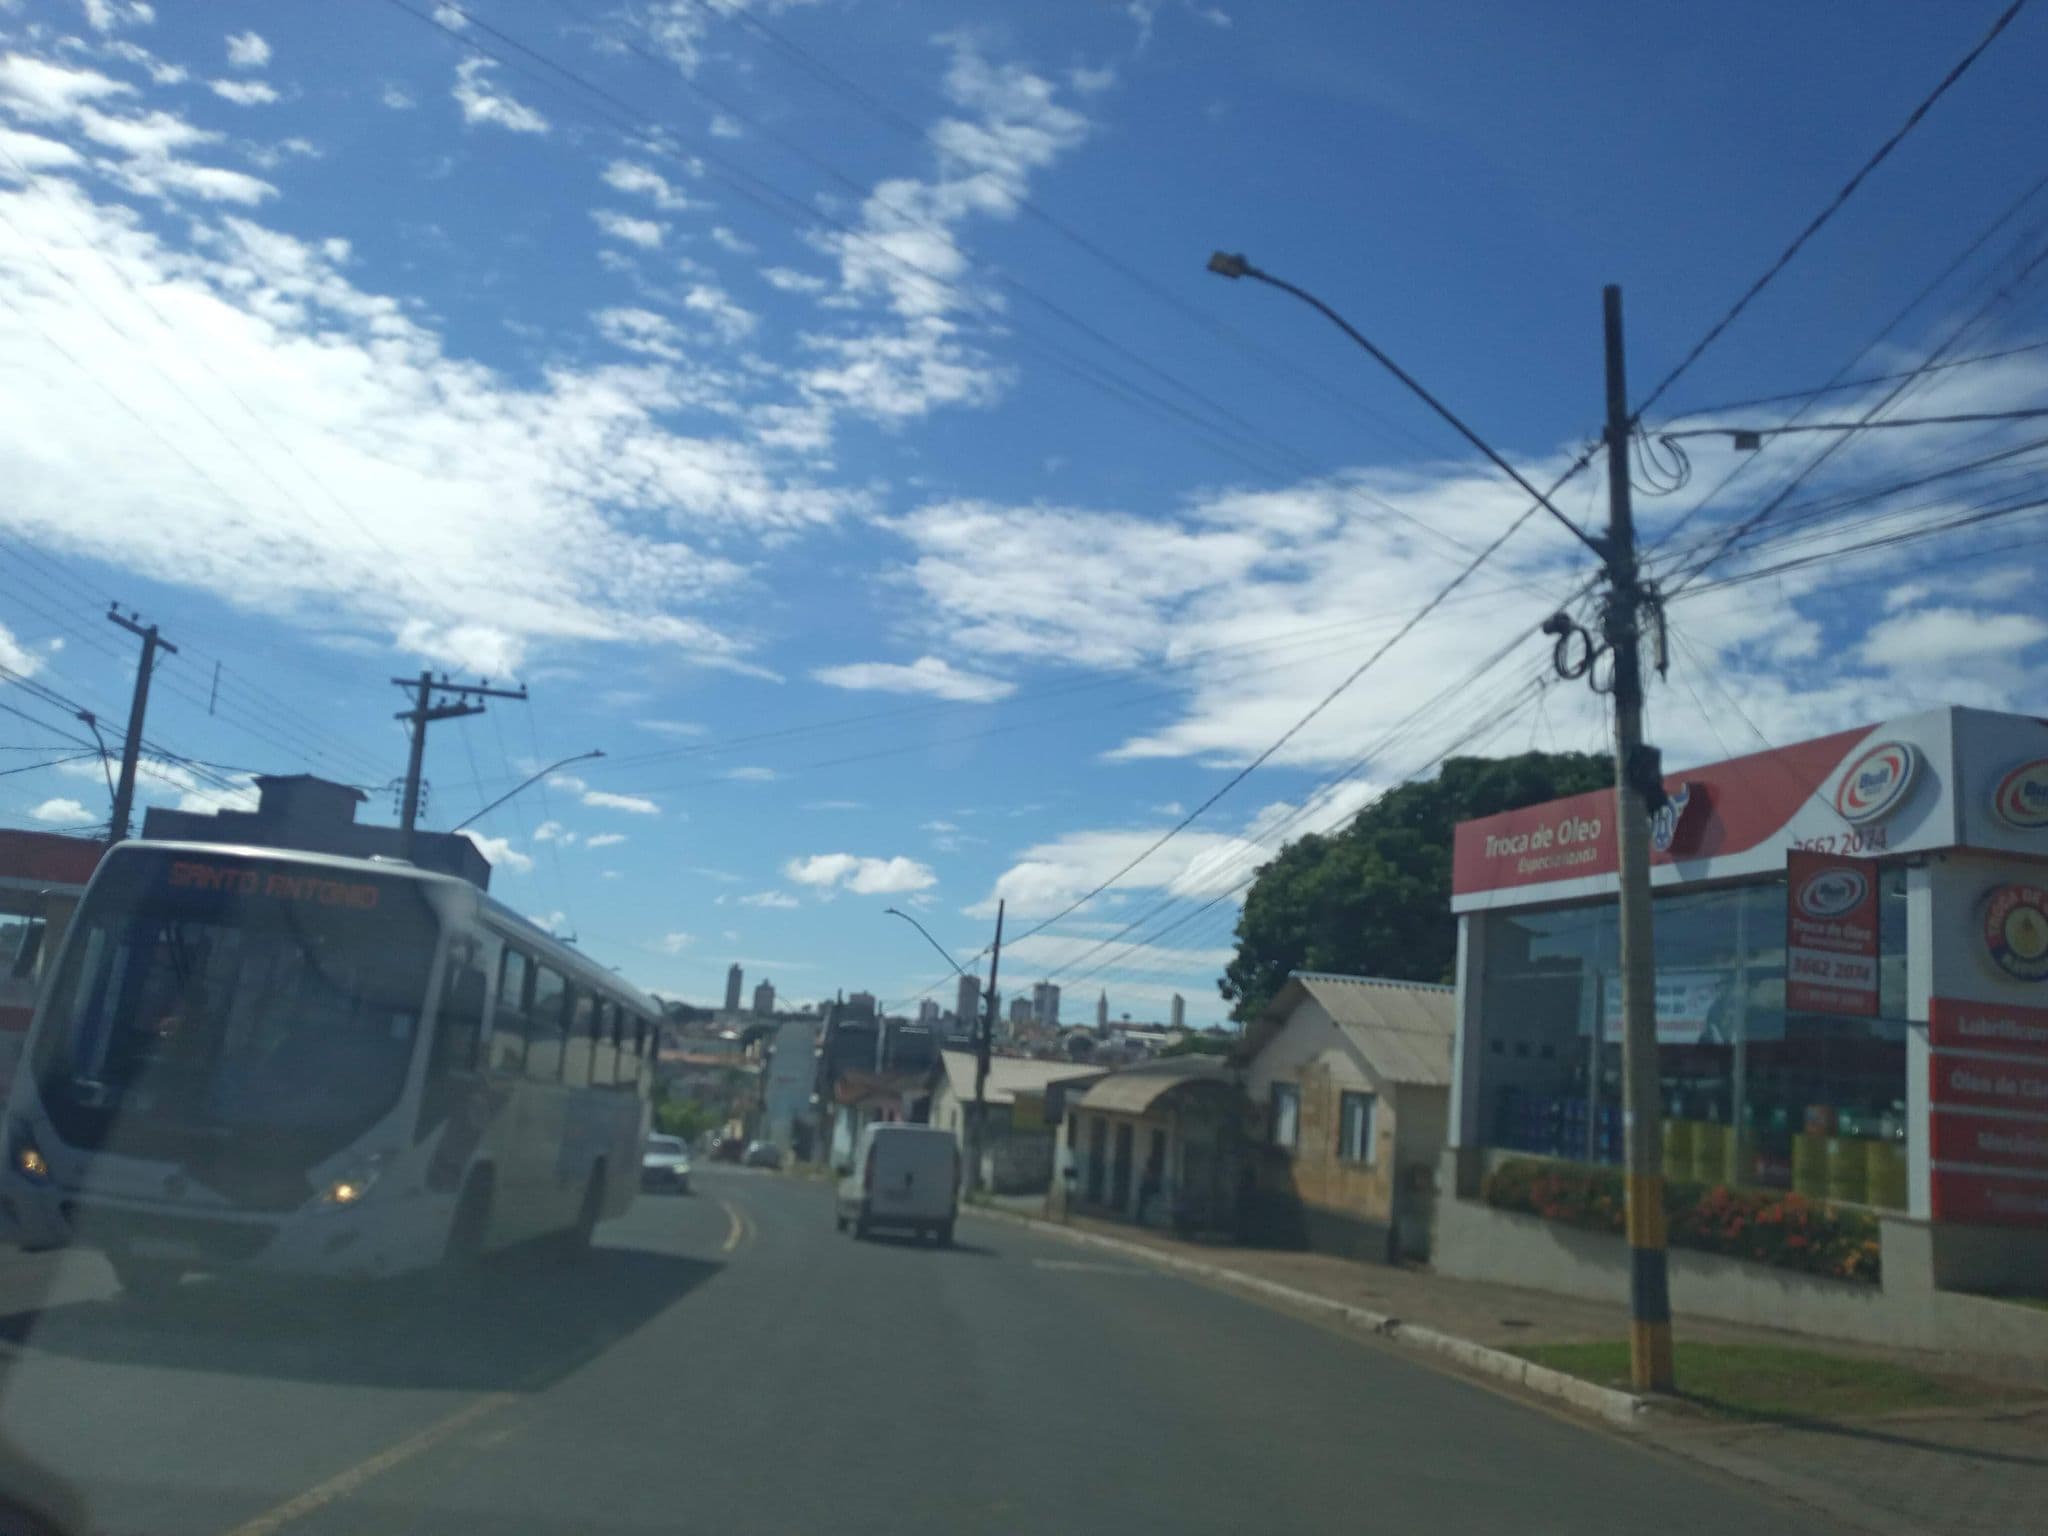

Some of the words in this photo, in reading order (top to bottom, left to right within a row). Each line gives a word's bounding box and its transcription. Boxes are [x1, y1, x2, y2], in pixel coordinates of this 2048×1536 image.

[1485, 833, 1529, 858] Troca
[1531, 823, 1553, 849] de
[169, 860, 257, 896] SANTO
